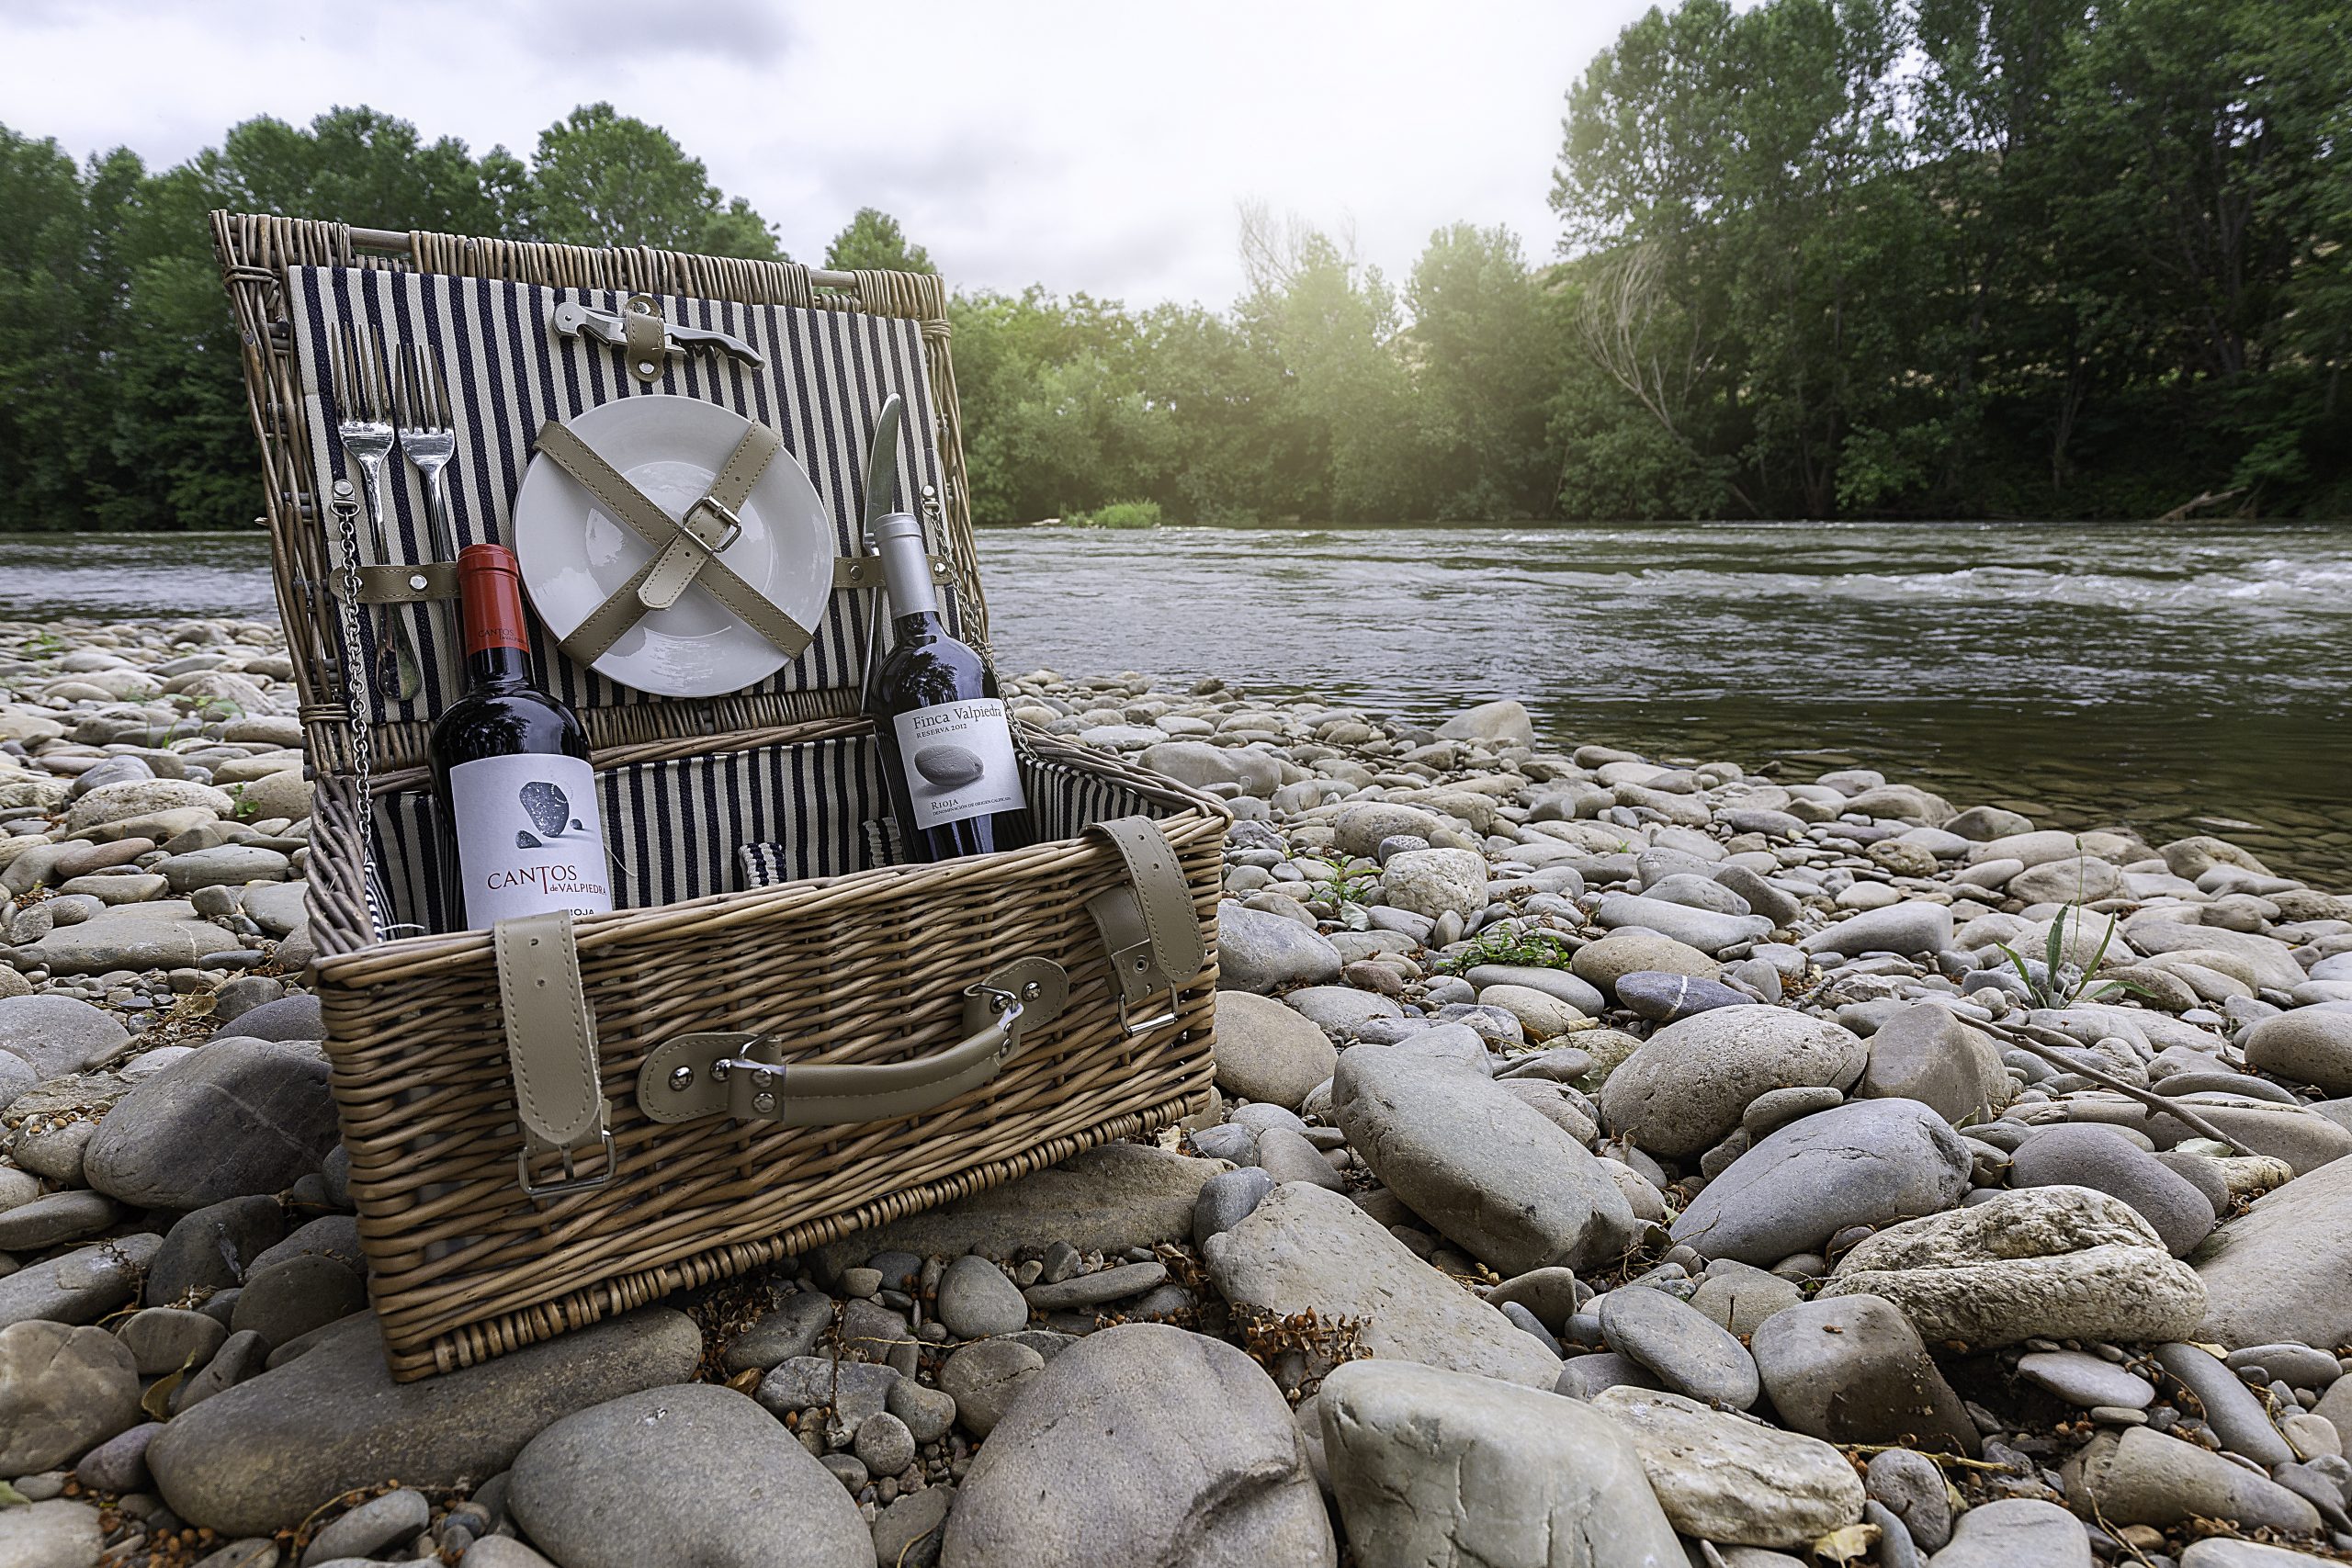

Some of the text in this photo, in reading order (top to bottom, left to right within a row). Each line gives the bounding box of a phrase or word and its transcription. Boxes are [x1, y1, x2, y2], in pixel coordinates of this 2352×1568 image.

[479, 628, 514, 640] CANTOS
[912, 704, 1002, 730] Finca Valpiedra
[916, 723, 967, 739] RESERVA 2012
[487, 865, 577, 895] CANTOS
[550, 883, 607, 896] de VALPIEDRA
